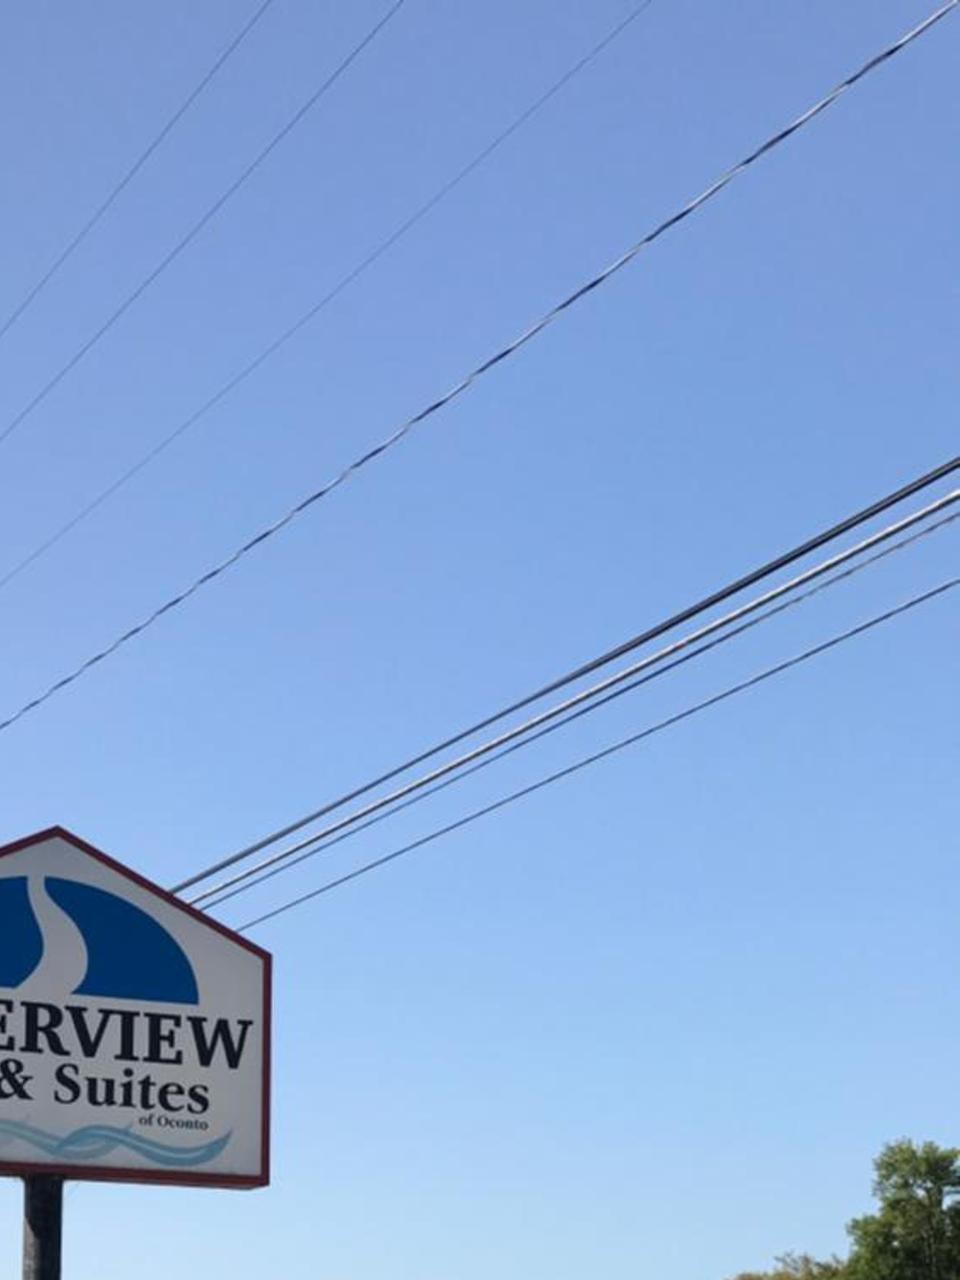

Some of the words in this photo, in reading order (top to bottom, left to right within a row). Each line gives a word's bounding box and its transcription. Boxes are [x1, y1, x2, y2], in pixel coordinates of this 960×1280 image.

[53, 1063, 209, 1115] Suites
[138, 1113, 155, 1127] of
[156, 1115, 209, 1131] Oconto
